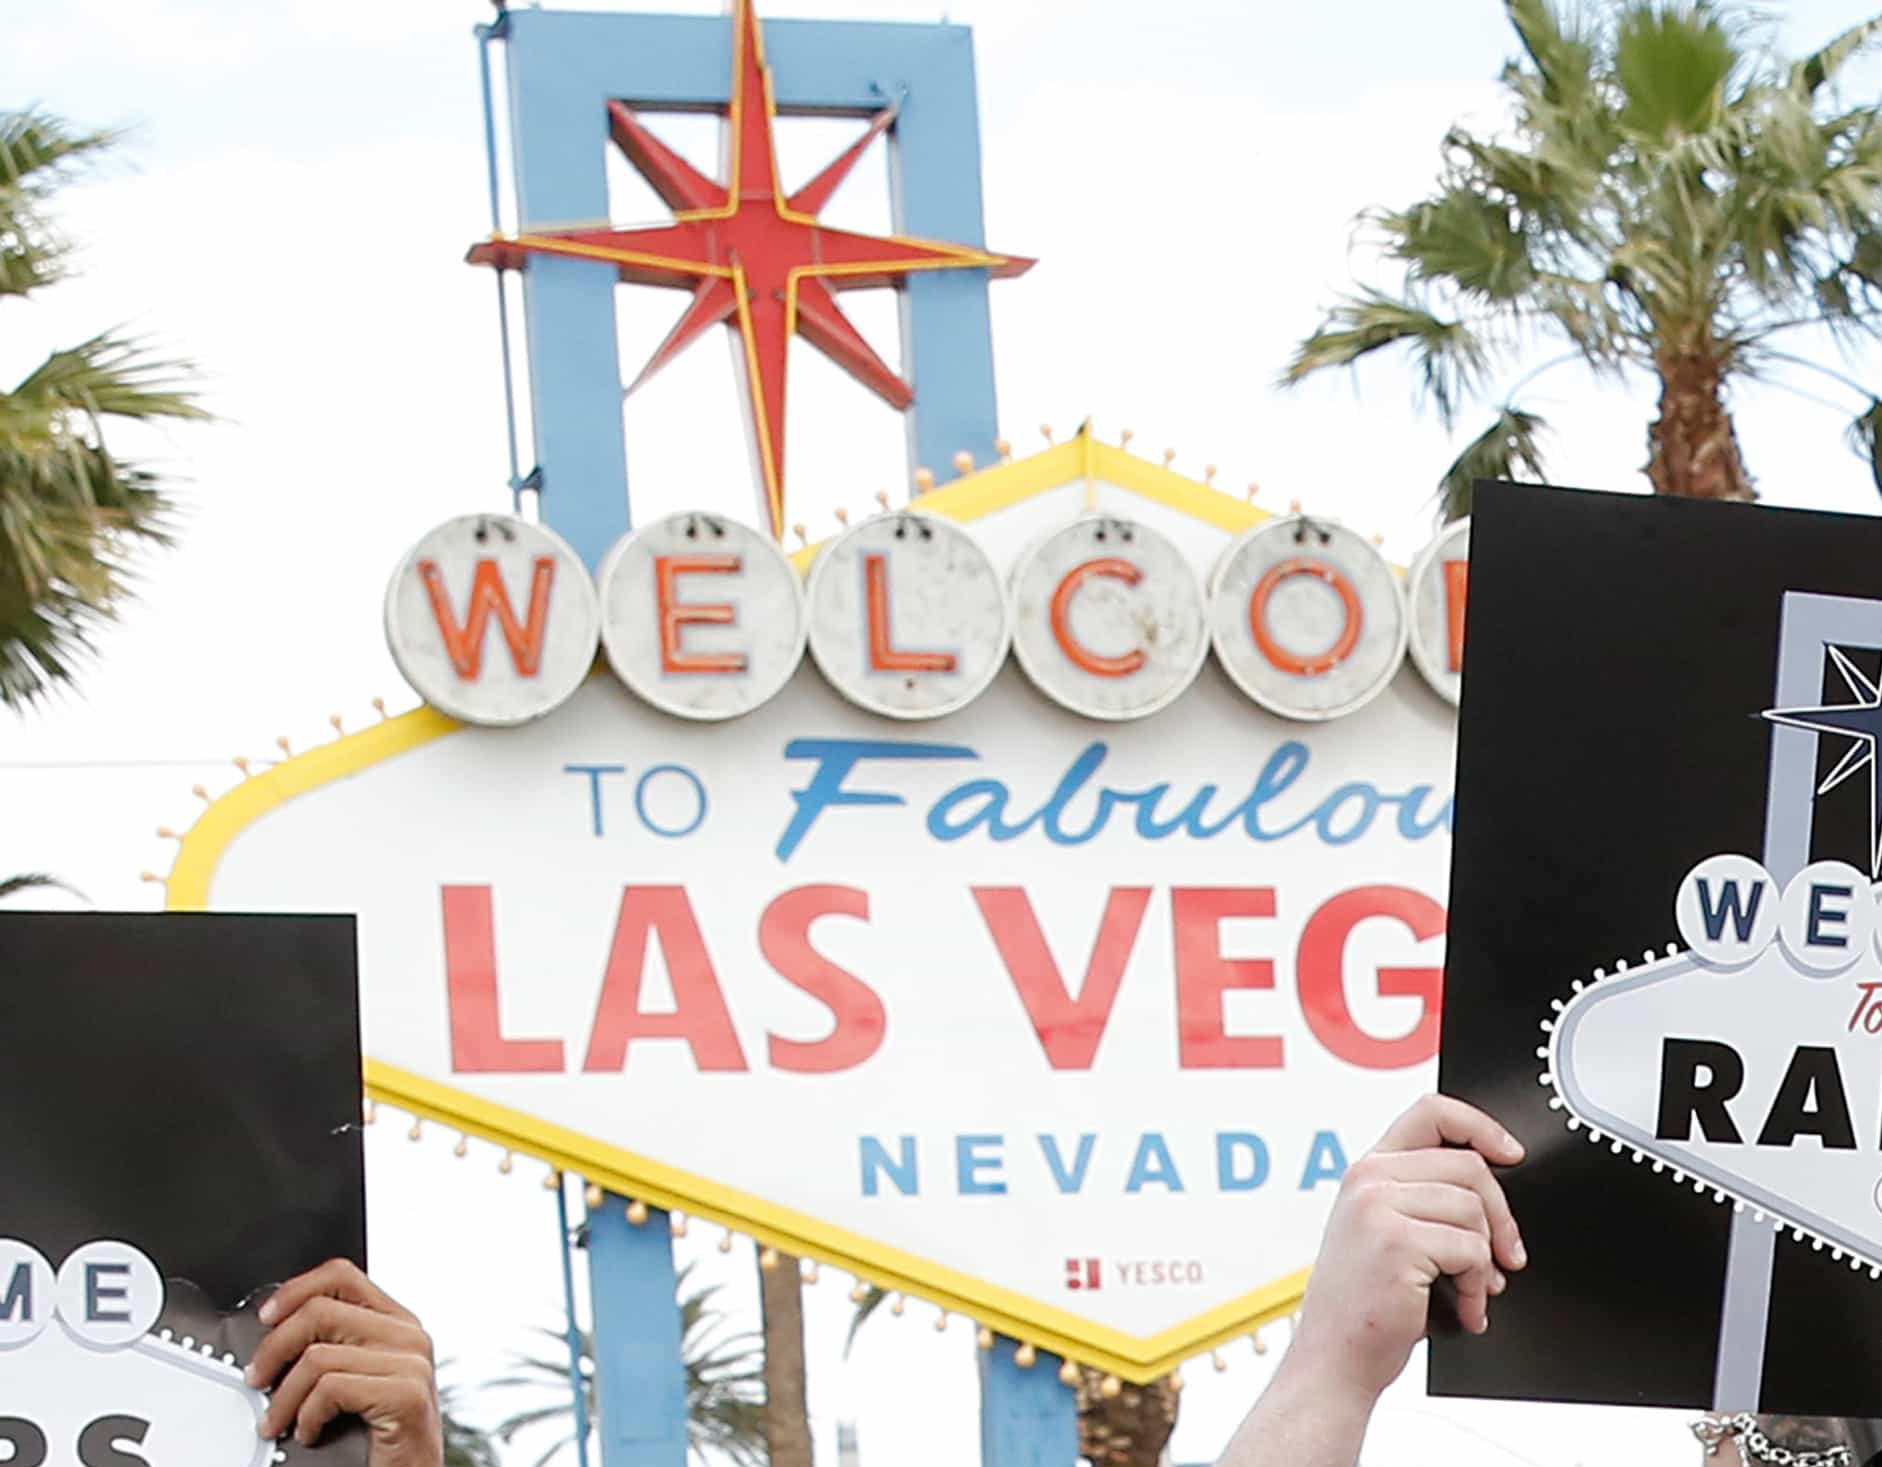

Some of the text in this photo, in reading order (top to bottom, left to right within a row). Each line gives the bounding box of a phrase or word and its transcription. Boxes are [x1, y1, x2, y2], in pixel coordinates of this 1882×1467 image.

[418, 556, 1468, 681] WELCO
[563, 737, 1454, 864] TO Fabulou
[440, 883, 888, 1075] LAS
[858, 1130, 1349, 1197] NEVADA
[1115, 1259, 1203, 1285] YESCO
